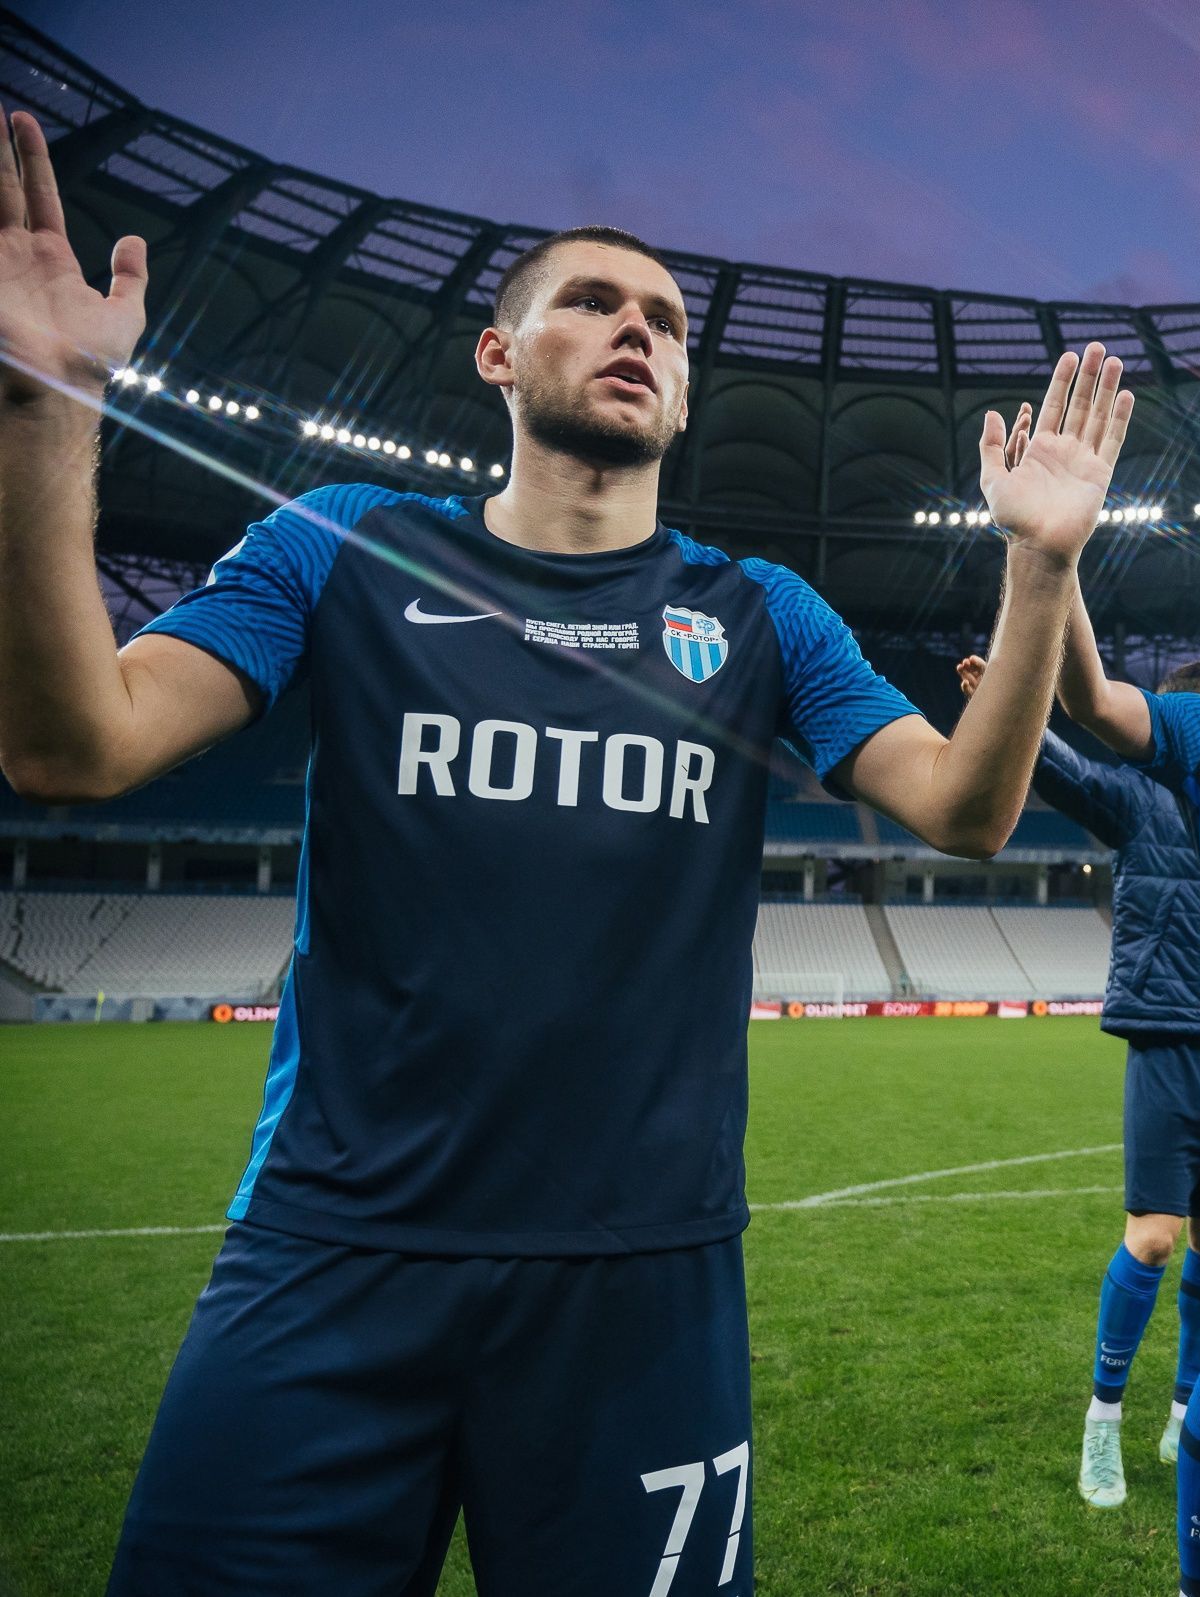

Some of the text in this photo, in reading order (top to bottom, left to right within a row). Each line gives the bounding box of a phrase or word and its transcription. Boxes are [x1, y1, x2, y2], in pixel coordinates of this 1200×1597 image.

[671, 629, 682, 637] СК
[397, 712, 716, 824] ROTOR
[1100, 1354, 1129, 1367] FCRV
[640, 1440, 750, 1597] 77
